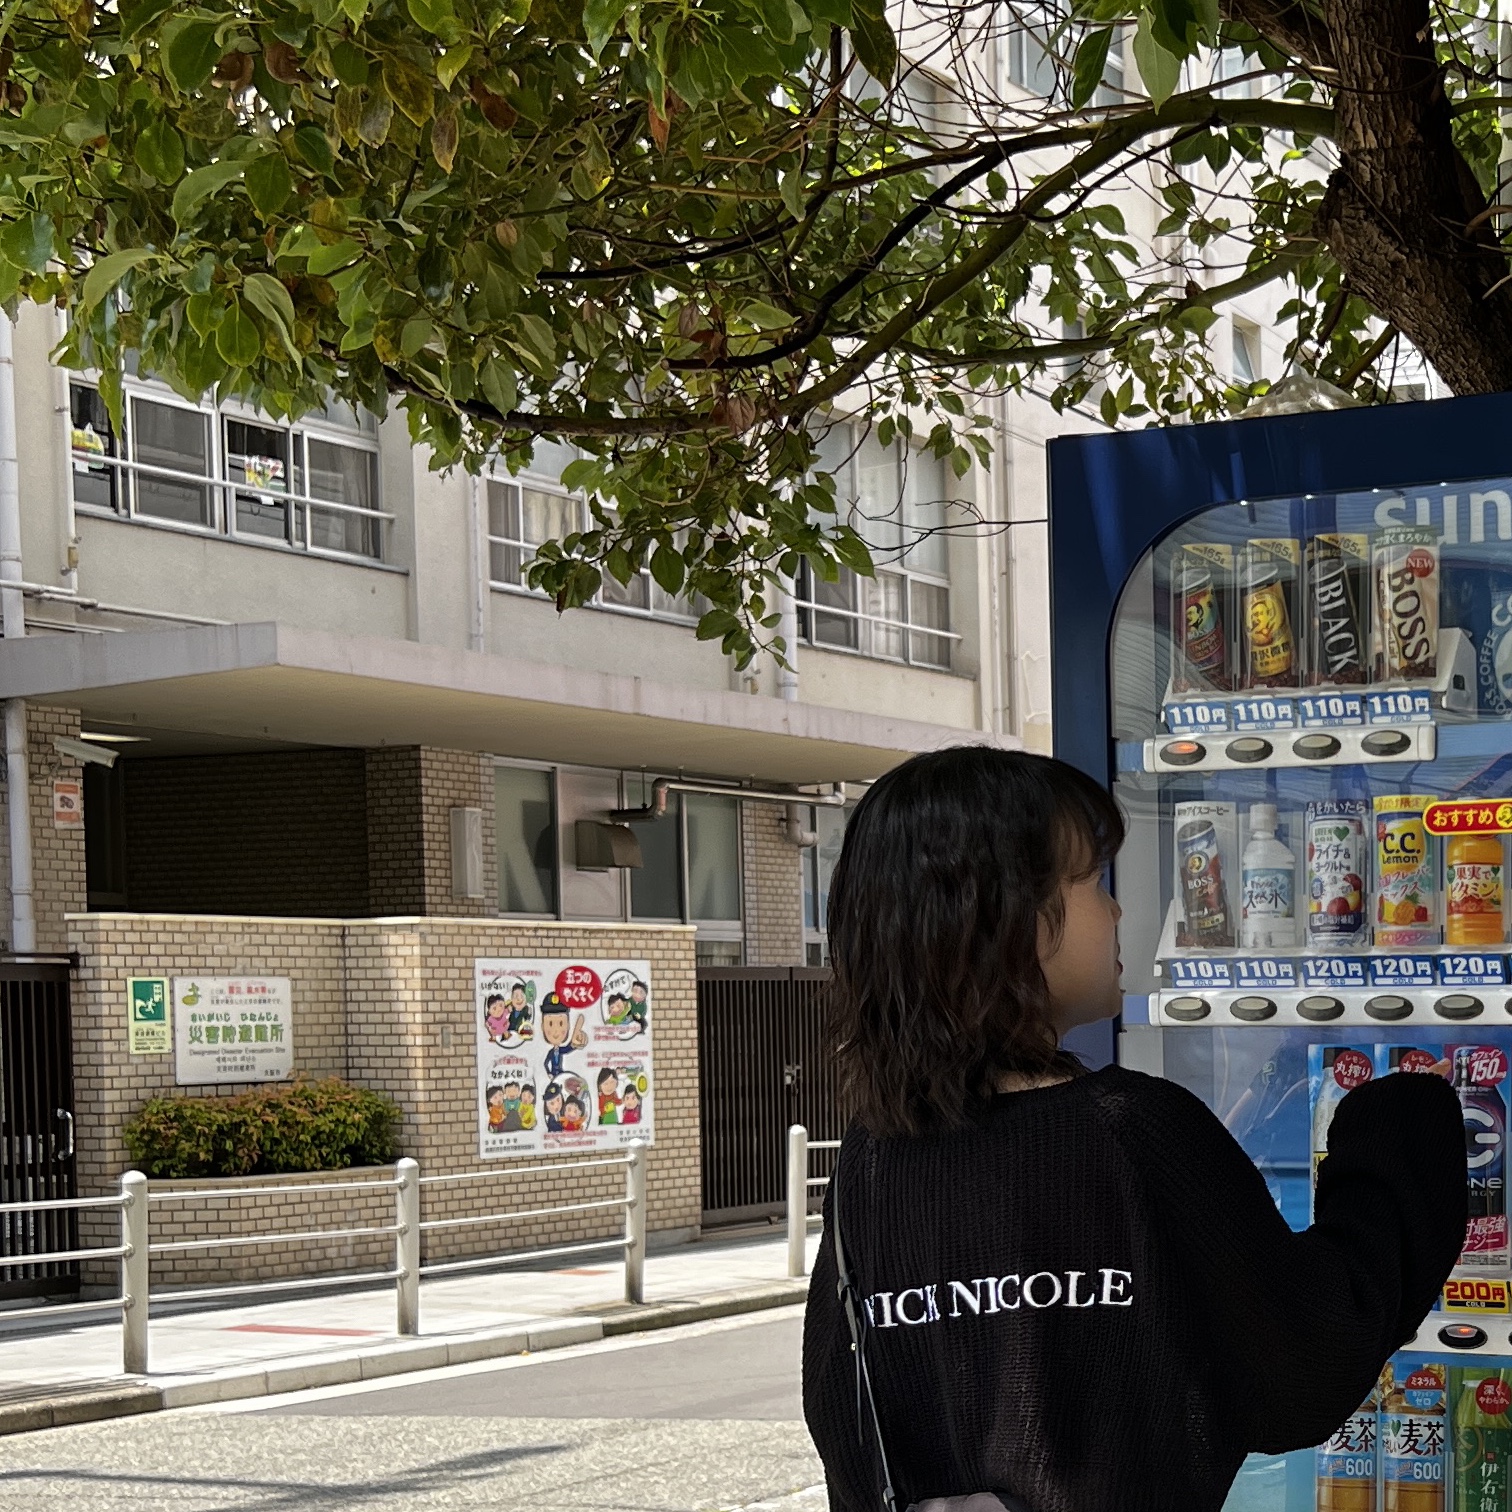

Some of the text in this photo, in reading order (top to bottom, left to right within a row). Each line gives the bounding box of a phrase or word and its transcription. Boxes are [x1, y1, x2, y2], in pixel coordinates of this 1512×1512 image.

[1407, 557, 1434, 569] NEW
[1387, 568, 1430, 664] BOSS
[1315, 577, 1360, 676] BLACK
[1234, 703, 1292, 721] 110円
[1302, 699, 1360, 718] 110円
[1369, 695, 1429, 714] 110円
[1170, 706, 1227, 724] 110円
[1433, 808, 1494, 827] おすすめ
[1383, 832, 1421, 854] C.C.
[1456, 865, 1491, 880] 果実で
[1171, 962, 1229, 978] 110円
[1236, 960, 1293, 978] 110円
[1303, 959, 1364, 977] 120円
[1370, 957, 1432, 976] 120円
[1441, 957, 1502, 975] 120円
[947, 1268, 1134, 1317] NICOLE
[1445, 1281, 1505, 1301] 200円
[1411, 1377, 1437, 1386] ミネラル
[1333, 1418, 1377, 1453] 麦茶
[1400, 1418, 1445, 1457] 麦茶
[1345, 1457, 1373, 1476] 600
[1413, 1461, 1441, 1480] 600
